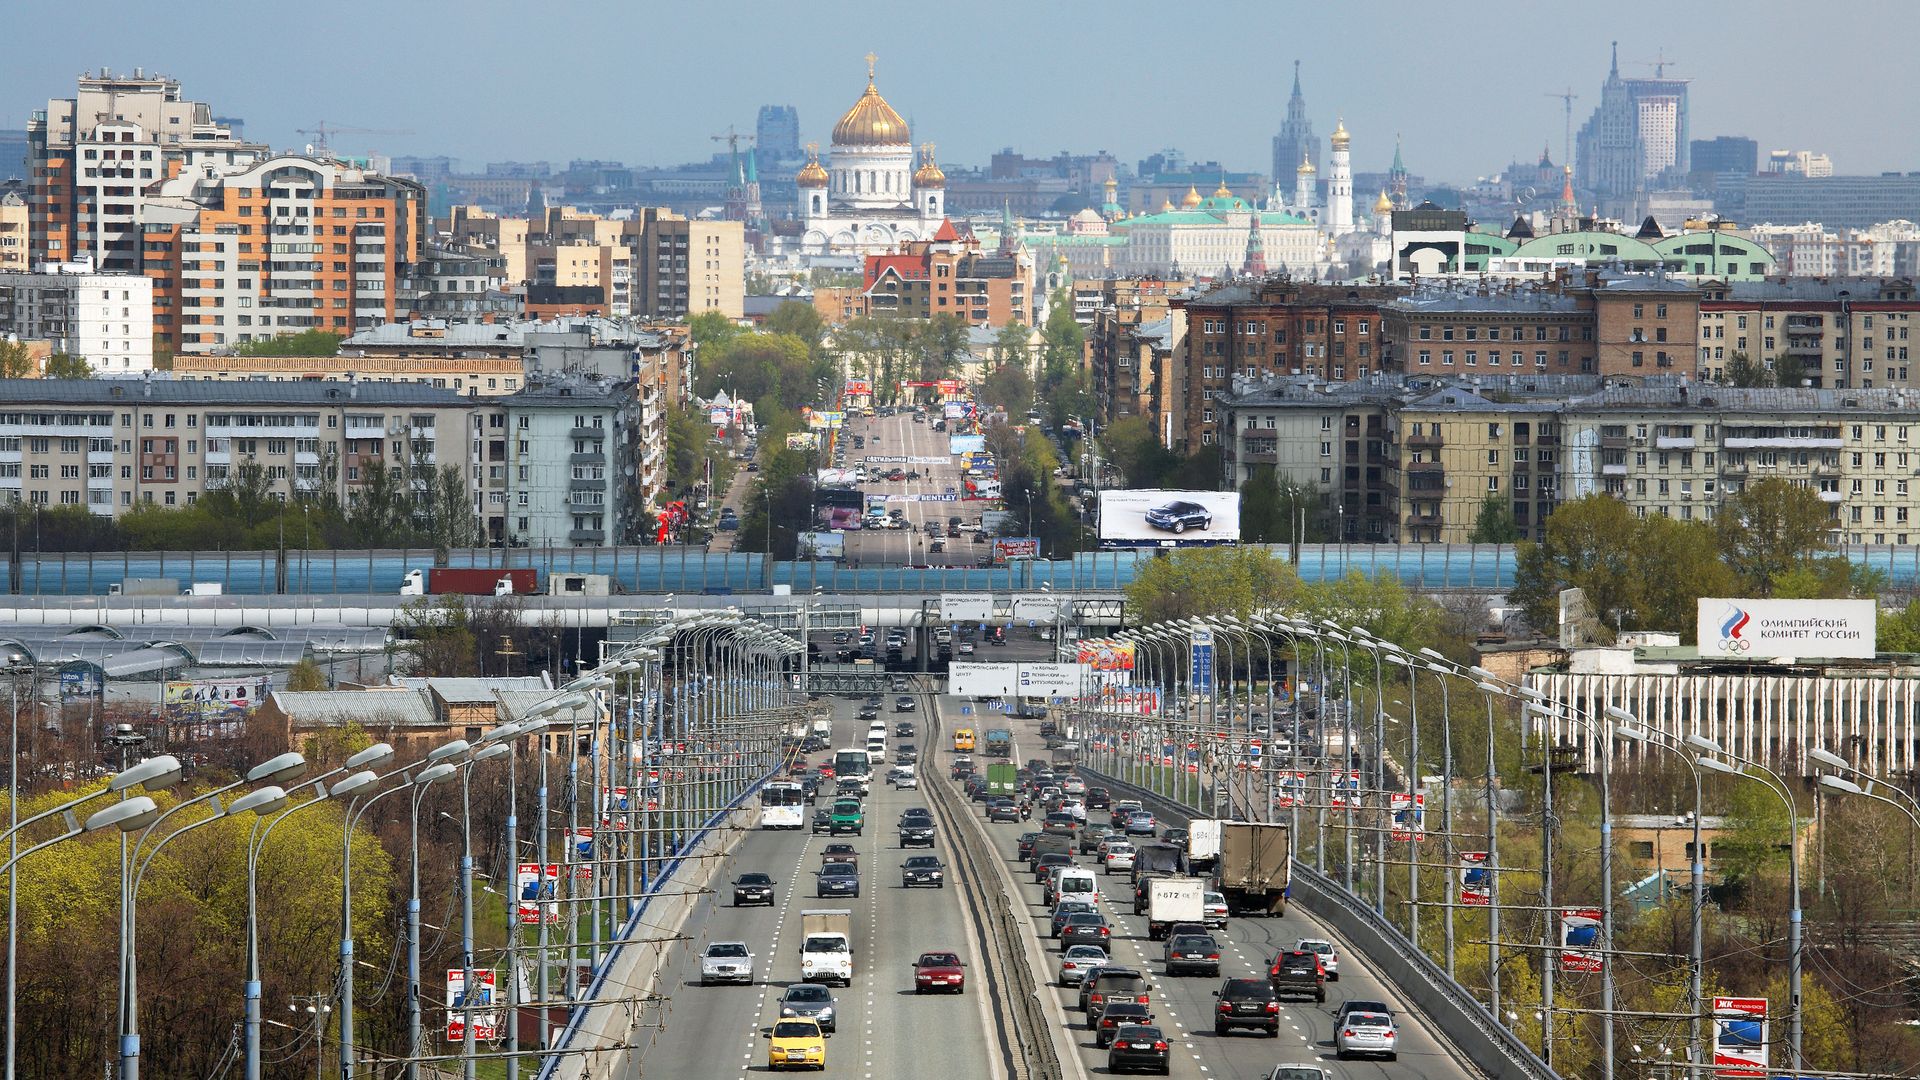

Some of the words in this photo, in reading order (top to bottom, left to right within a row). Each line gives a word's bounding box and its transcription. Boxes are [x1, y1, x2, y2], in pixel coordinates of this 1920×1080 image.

[1761, 618, 1847, 628] ОЛИМПИЙСКИЙ
[1761, 630, 1810, 639] КОМИТЕТ
[1815, 630, 1860, 639] РОССИИ
[1718, 1000, 1734, 1008] ЖК
